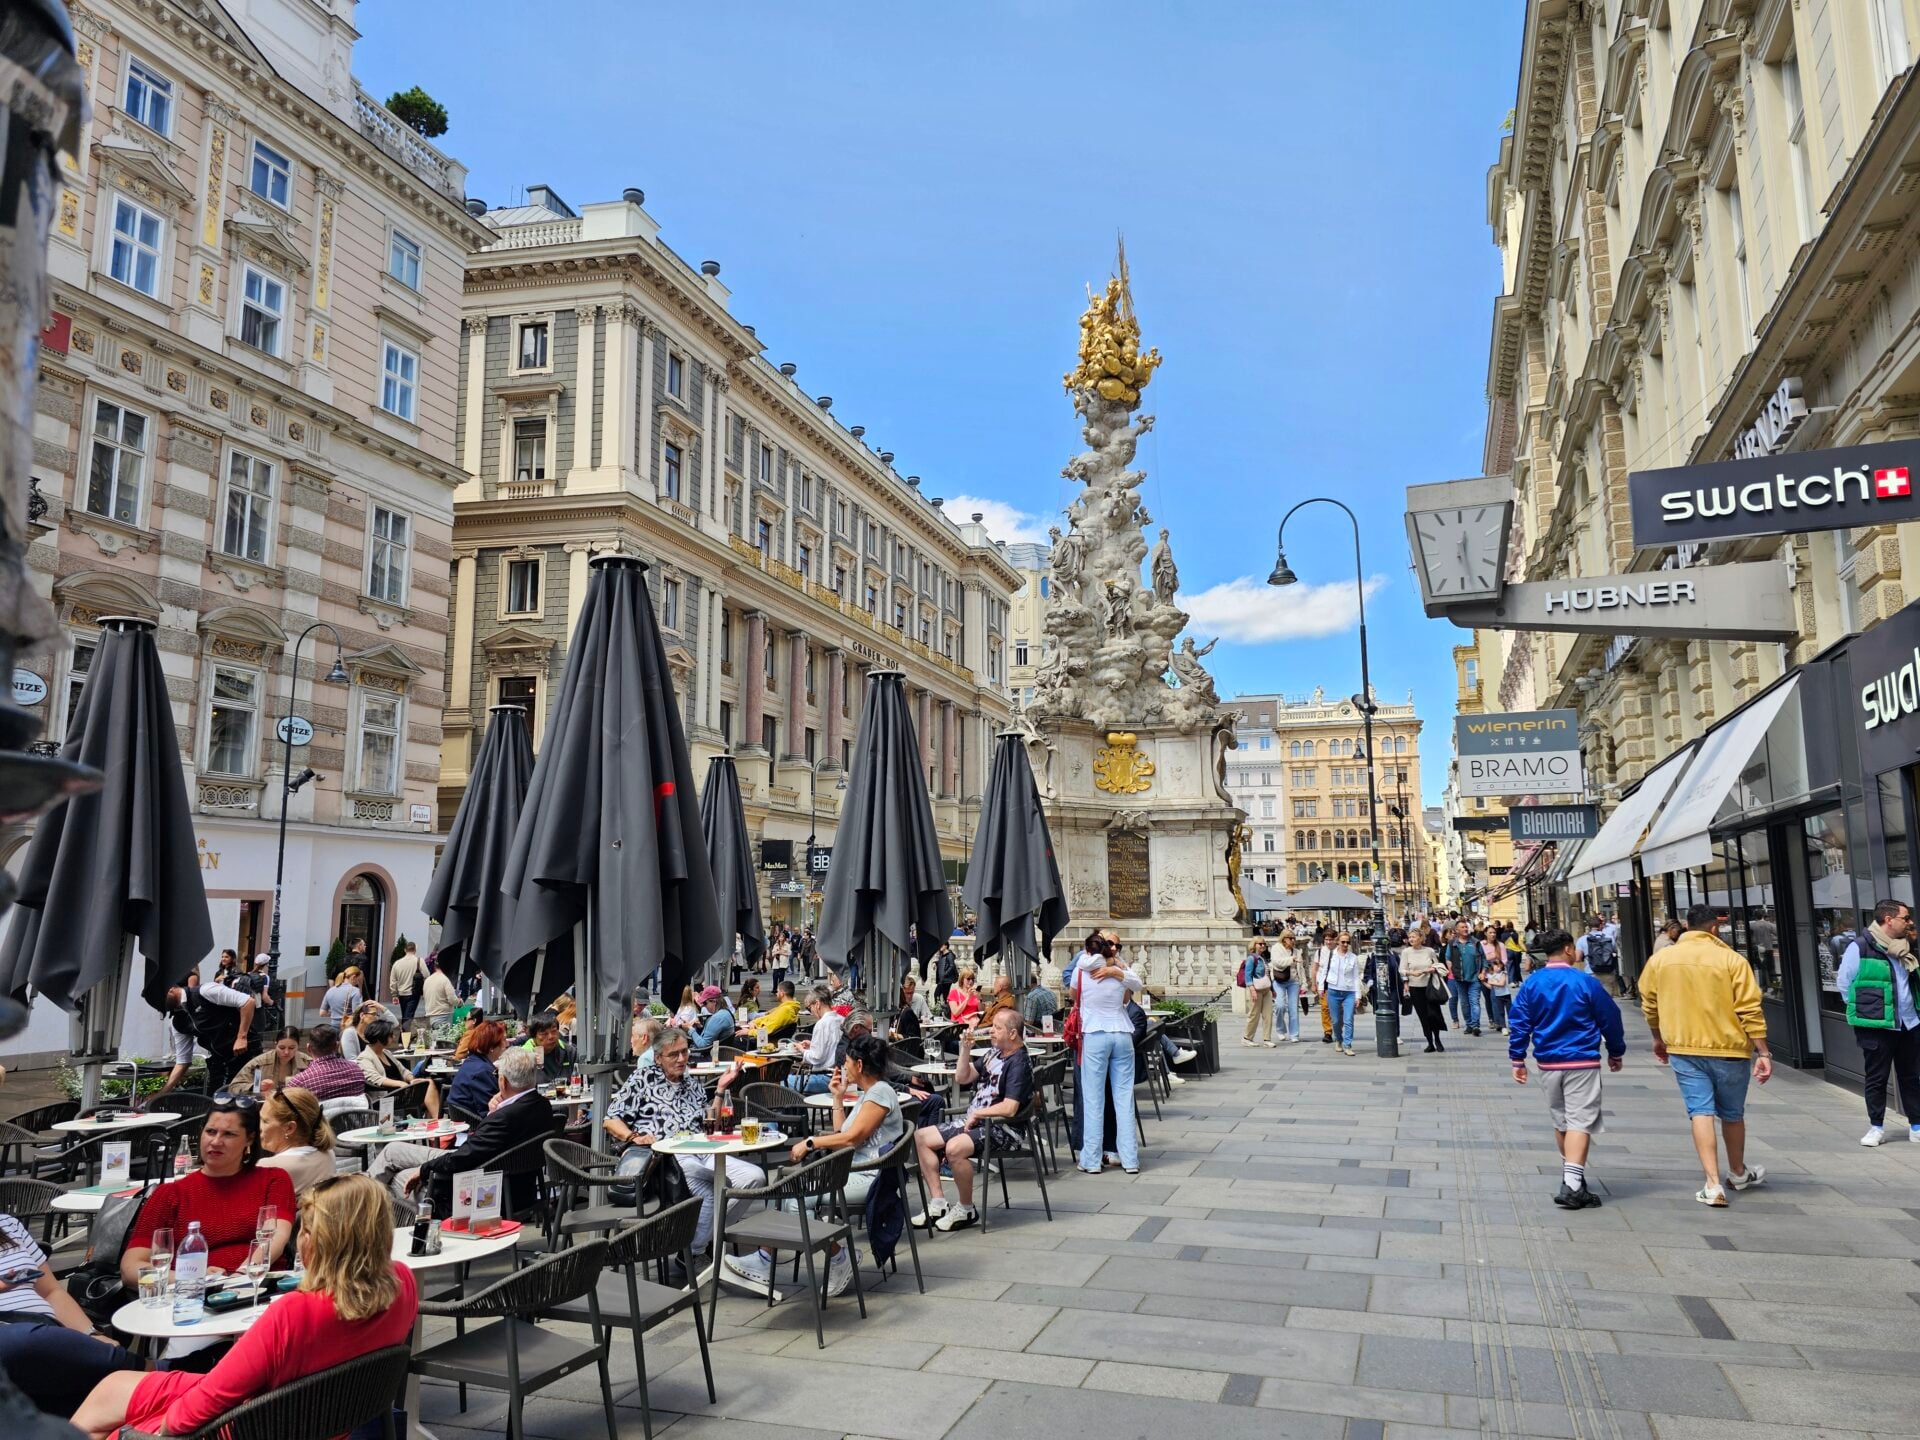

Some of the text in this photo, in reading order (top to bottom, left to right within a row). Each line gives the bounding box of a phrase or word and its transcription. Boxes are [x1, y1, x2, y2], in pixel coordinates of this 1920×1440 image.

[1660, 465, 1870, 522] swatch
[1545, 580, 1696, 612] HÜBNER
[11, 681, 42, 693] NIZE
[1467, 718, 1567, 734] wienerin
[1470, 756, 1569, 778] BRAMO
